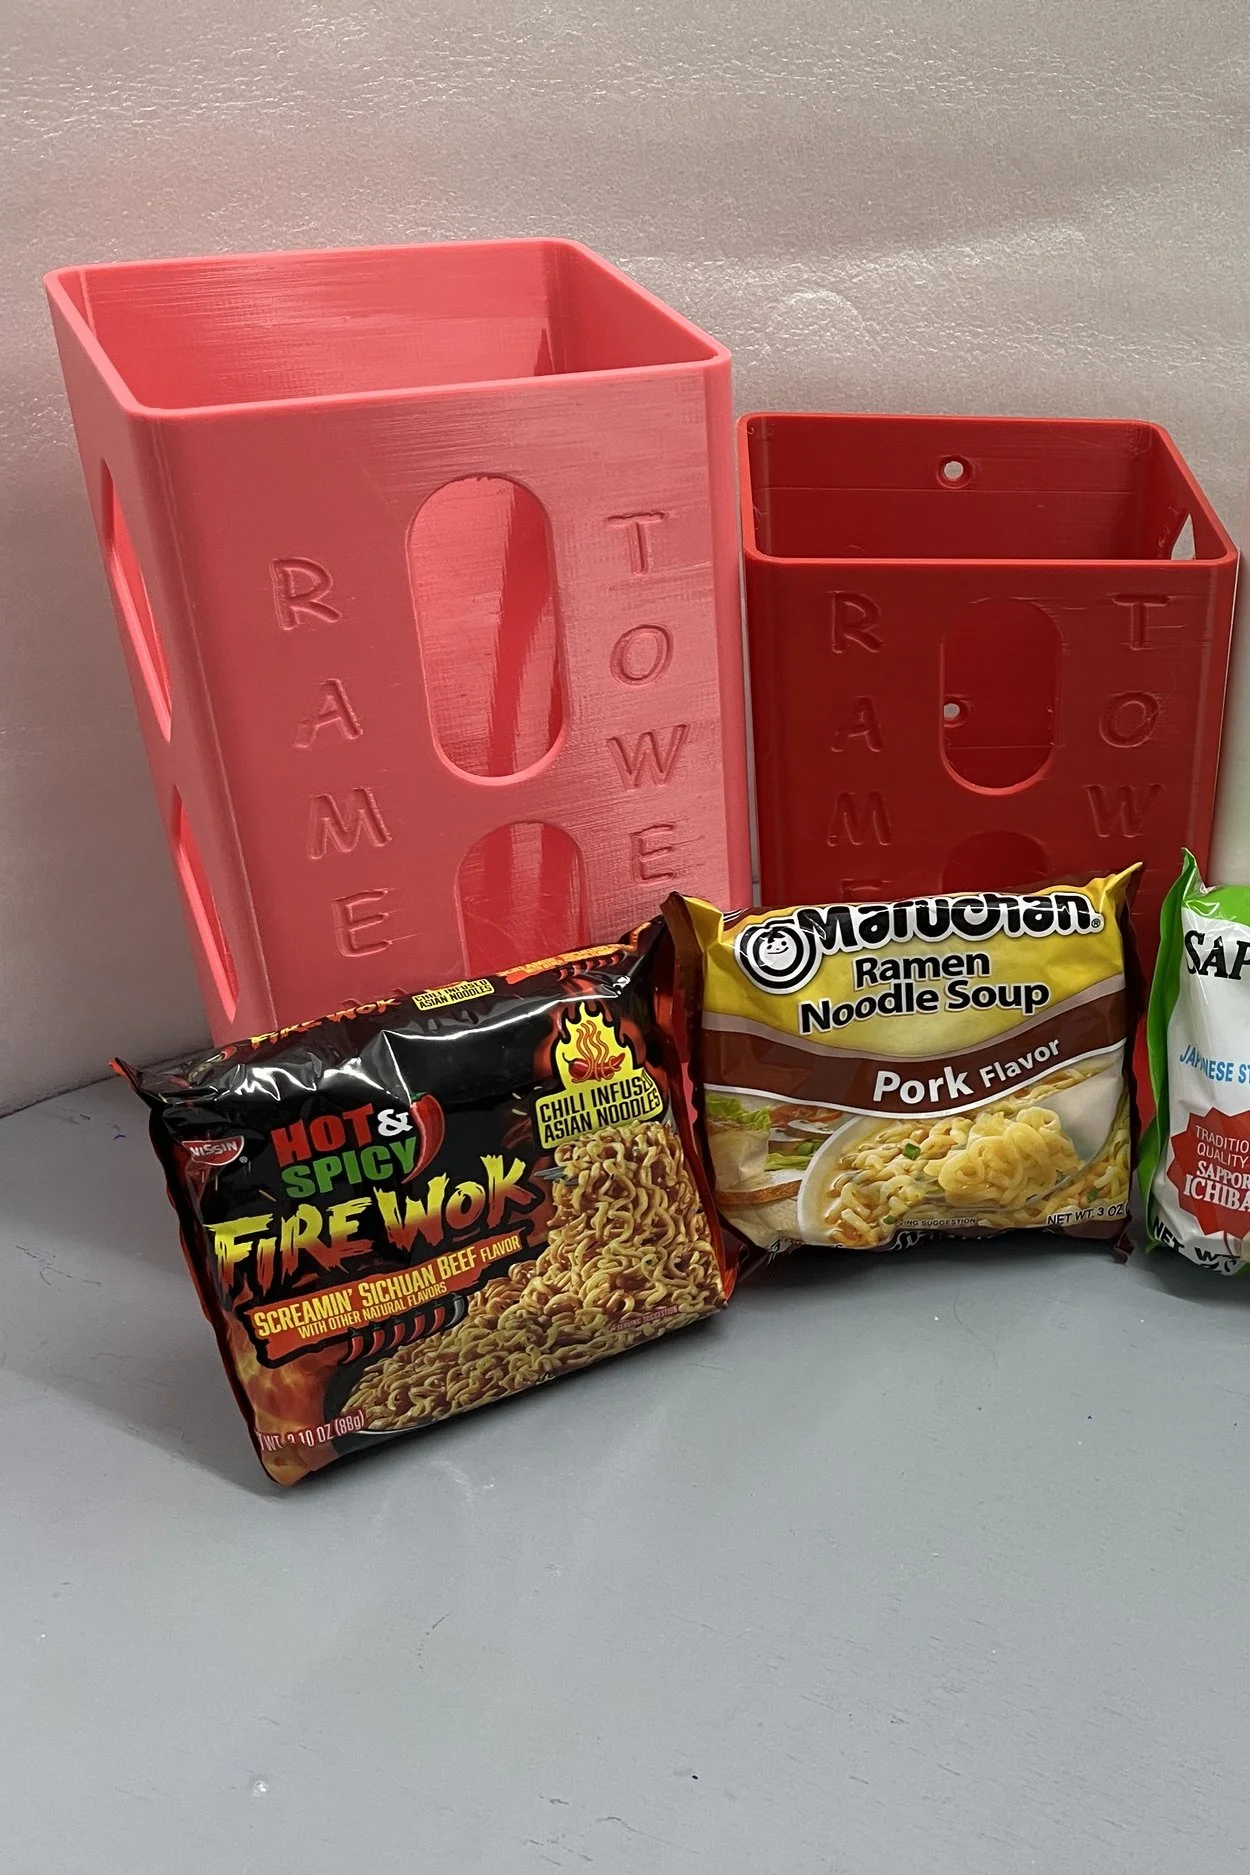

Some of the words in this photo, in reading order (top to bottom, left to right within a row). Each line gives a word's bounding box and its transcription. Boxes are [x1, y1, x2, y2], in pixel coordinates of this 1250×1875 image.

[269, 557, 394, 957] RAME
[799, 893, 1093, 953] Maruchan
[856, 952, 990, 988] Ramen
[802, 983, 943, 1034] Noodle
[949, 980, 1049, 1014] Soup
[873, 1066, 974, 1104] Pork
[979, 1039, 1060, 1088] Flavor
[271, 1103, 374, 1167] HOT
[377, 1109, 413, 1137] &
[540, 1092, 585, 1123] CHILI
[545, 1111, 592, 1143] ASIAN
[596, 1087, 661, 1127] NOODLES
[190, 1141, 237, 1157] NISSIN
[281, 1136, 416, 1198] SPICY
[1197, 1142, 1249, 1169] QUALITY
[1048, 1213, 1072, 1225] NET
[1098, 1207, 1104, 1216] 3
[1107, 1204, 1124, 1217] OZ
[253, 1289, 352, 1337] SCREAMIN'
[358, 1264, 435, 1306] SICHUAN
[438, 1246, 478, 1279] BEEF
[480, 1235, 521, 1262] FLAVOR
[297, 1318, 328, 1339] WITH
[329, 1310, 361, 1331] OTHER
[363, 1296, 406, 1320] NATURAL
[408, 1282, 447, 1306] FLAVORS
[316, 1424, 334, 1443] OZ
[335, 1410, 364, 1436] (88g)
